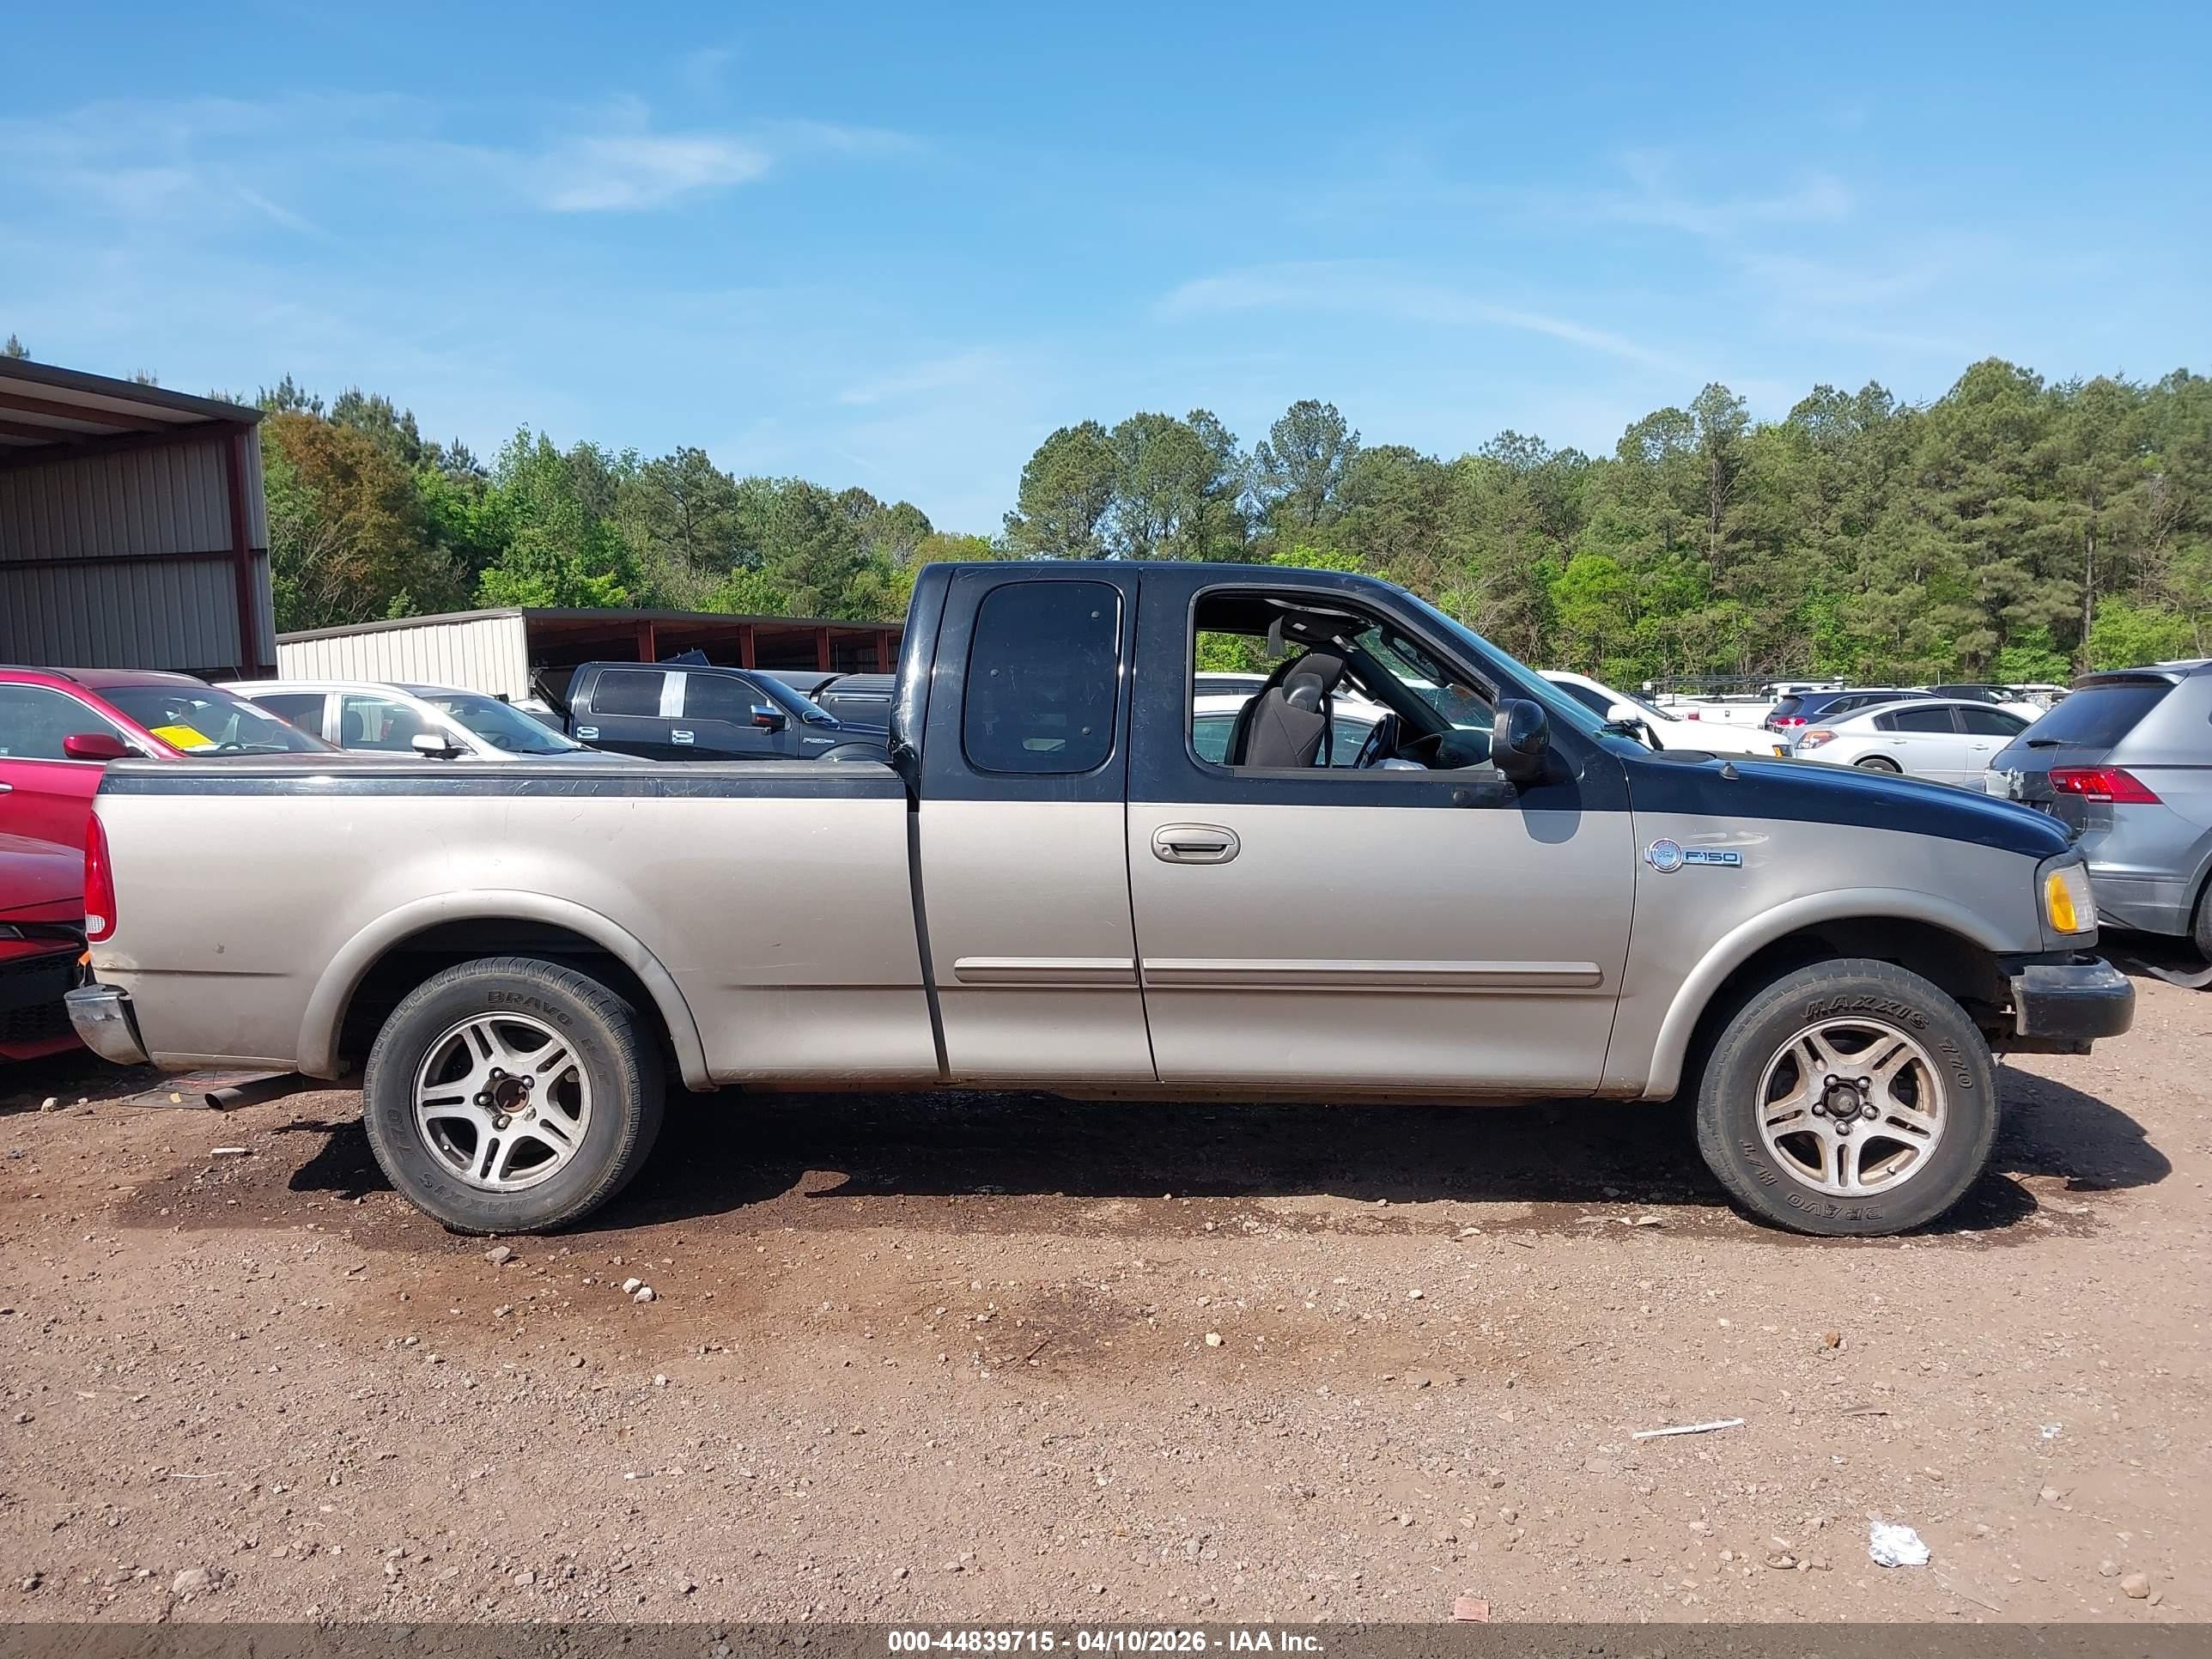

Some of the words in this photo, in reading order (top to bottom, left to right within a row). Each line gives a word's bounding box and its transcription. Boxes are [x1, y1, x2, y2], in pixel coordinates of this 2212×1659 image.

[488, 991, 574, 1026] BRAVO
[1801, 994, 1930, 1030] MAXXIS
[1738, 1139, 1779, 1187] H/T
[419, 1171, 530, 1215] MAXXIS
[1786, 1192, 1883, 1221] BRAVO
